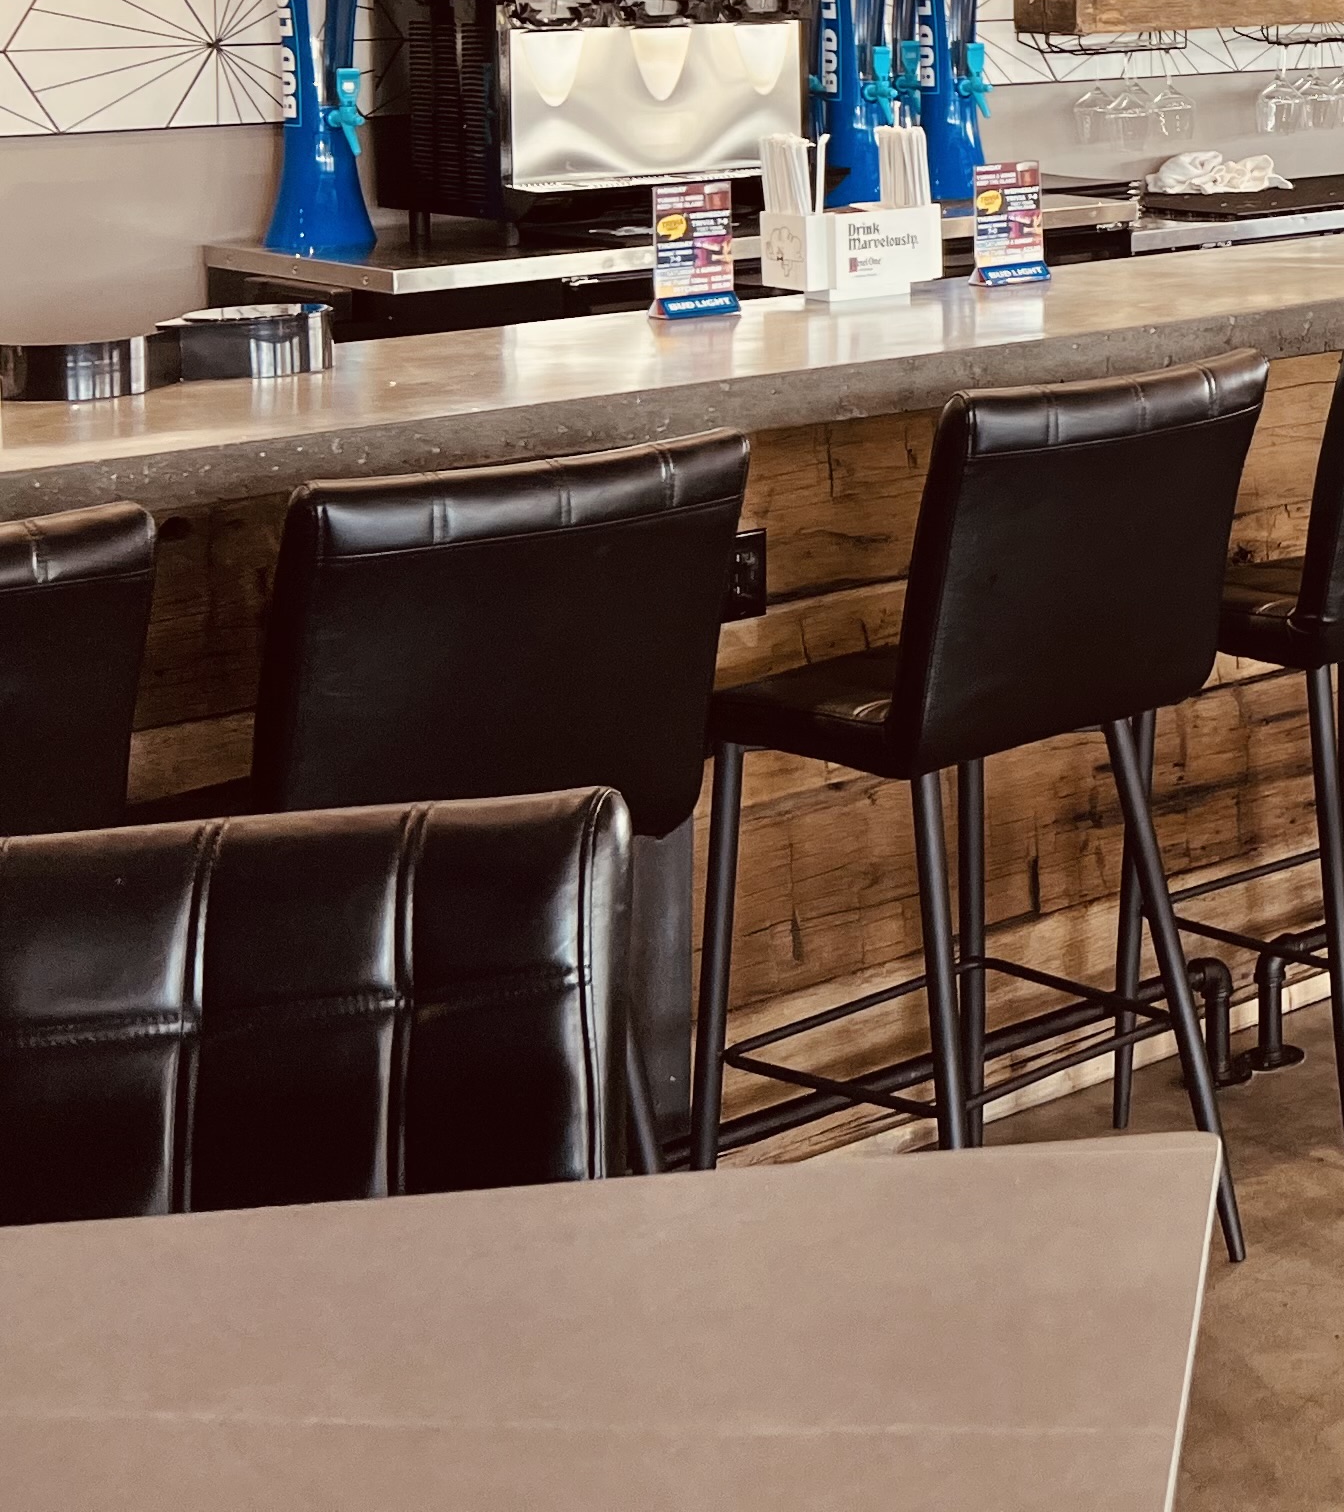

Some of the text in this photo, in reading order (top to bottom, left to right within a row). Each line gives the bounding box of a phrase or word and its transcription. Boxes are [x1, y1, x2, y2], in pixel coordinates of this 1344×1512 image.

[824, 28, 838, 94] BUD
[919, 24, 936, 87] BUD
[281, 46, 297, 119] BUD
[848, 222, 880, 237] Drink
[988, 267, 1043, 279] BUD LIGHT
[668, 296, 731, 311] BUD LIGHT
